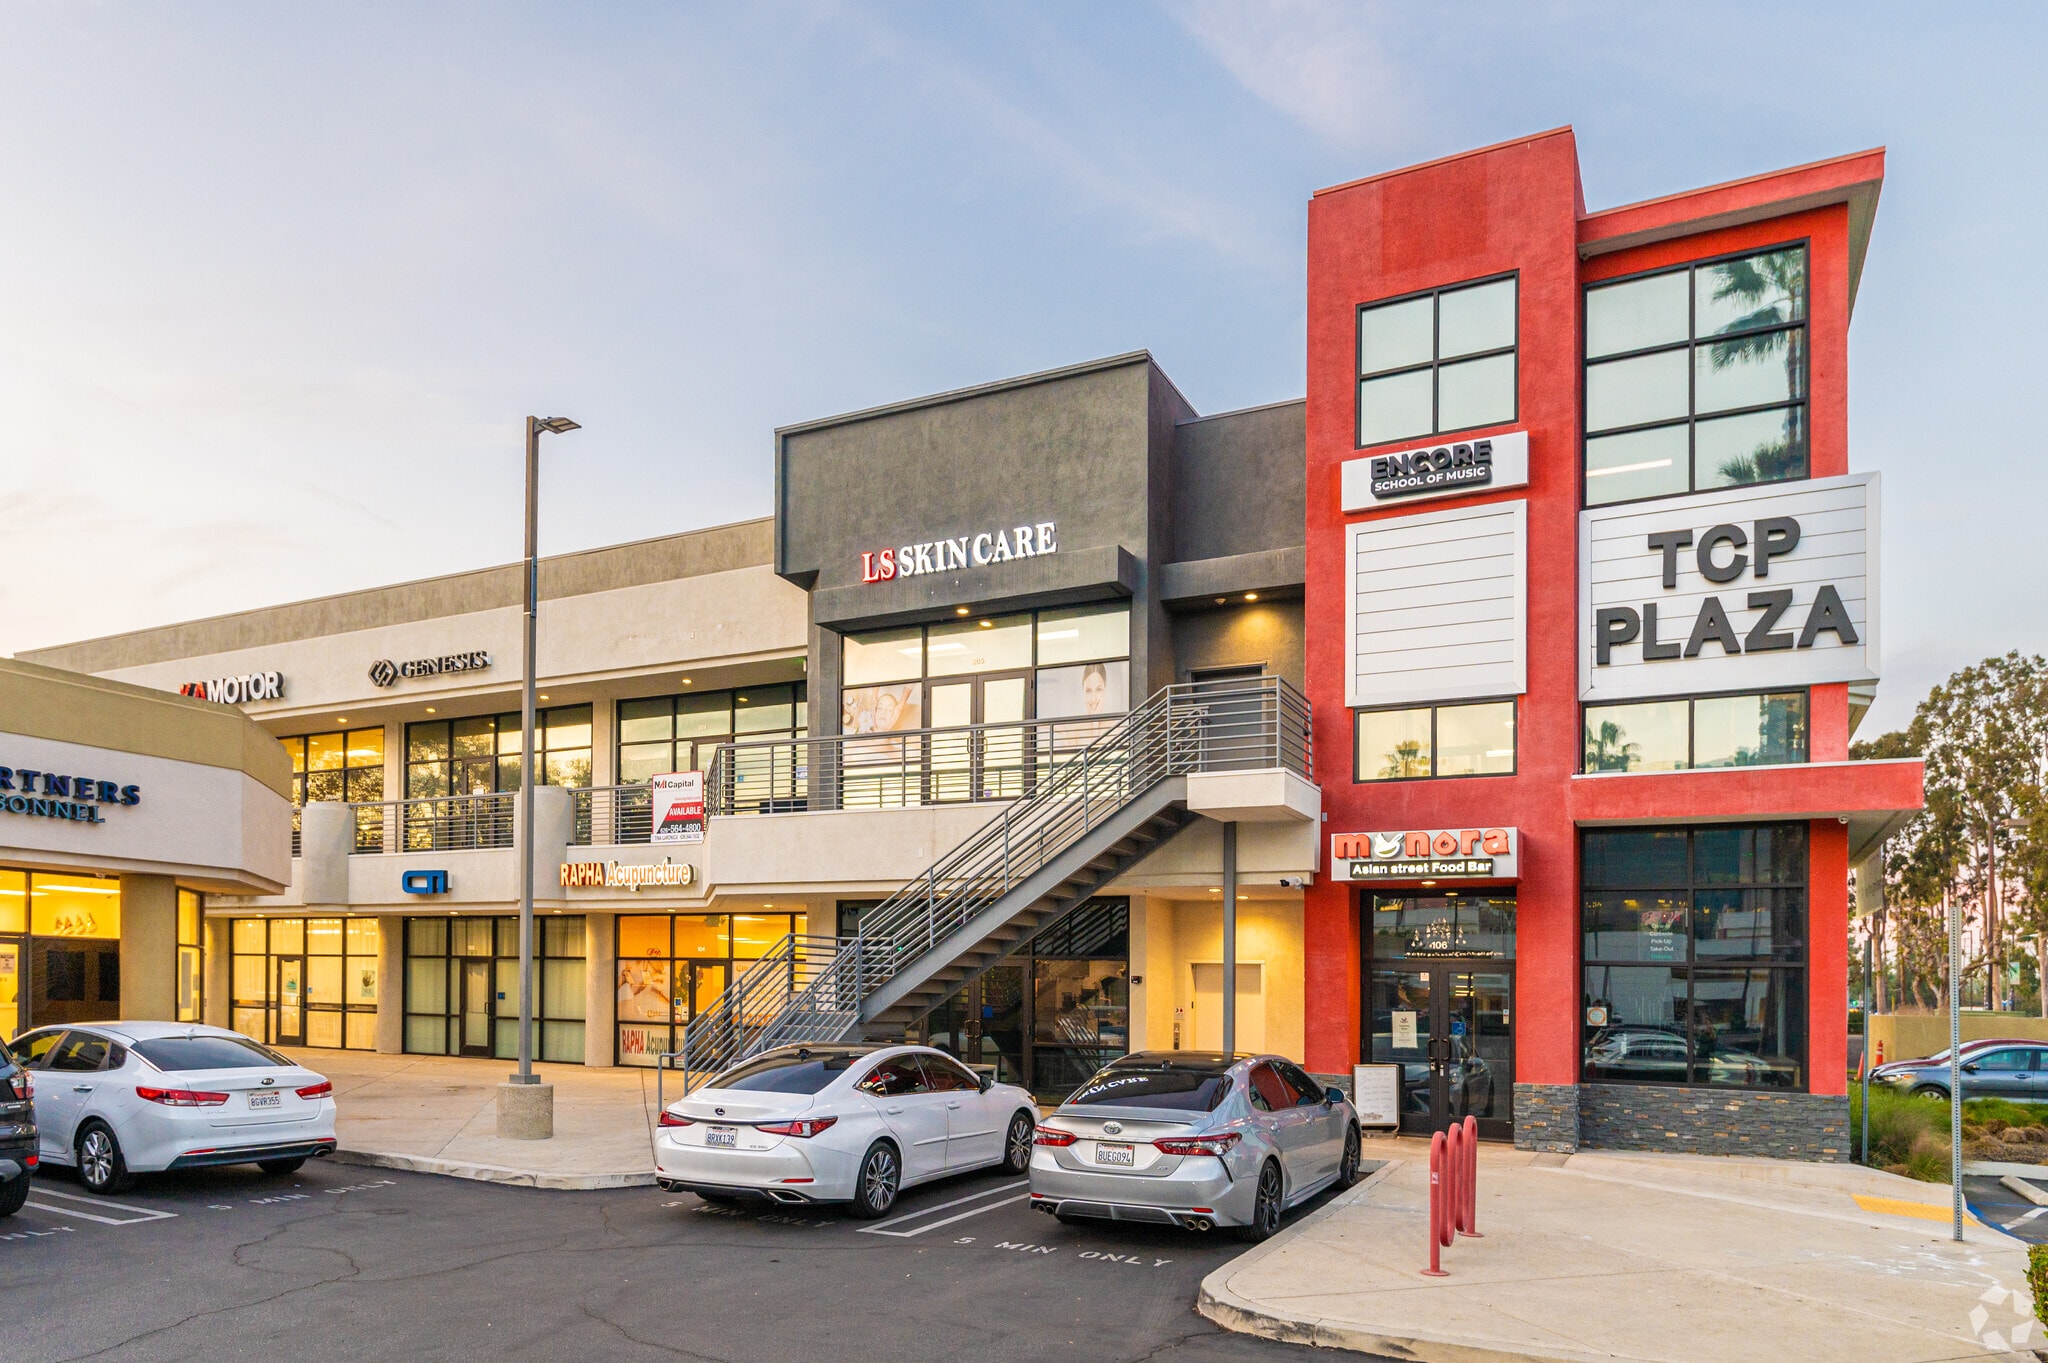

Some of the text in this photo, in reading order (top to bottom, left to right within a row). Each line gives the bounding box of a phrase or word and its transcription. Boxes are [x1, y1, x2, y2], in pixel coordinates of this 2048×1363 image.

[1371, 440, 1492, 479] ENCORE
[1375, 467, 1486, 492] SCHOOL OF MUSIC
[862, 522, 1058, 583] LS SKIN CARE
[1648, 516, 1801, 589] TCP
[1596, 584, 1859, 665] PLAZA
[399, 650, 489, 678] GENESIS
[206, 671, 284, 704] MOTOR
[654, 779, 694, 789] NAI Capital
[669, 806, 702, 816] AVAILABLE
[560, 856, 693, 891] RAPHA Acupuncture
[1352, 861, 1491, 875] Asian street Food Bar
[622, 1030, 644, 1055] RAPHA
[1097, 1151, 1130, 1162] 8UEG094
[953, 1236, 1173, 1267] 5 MIN ONLY
